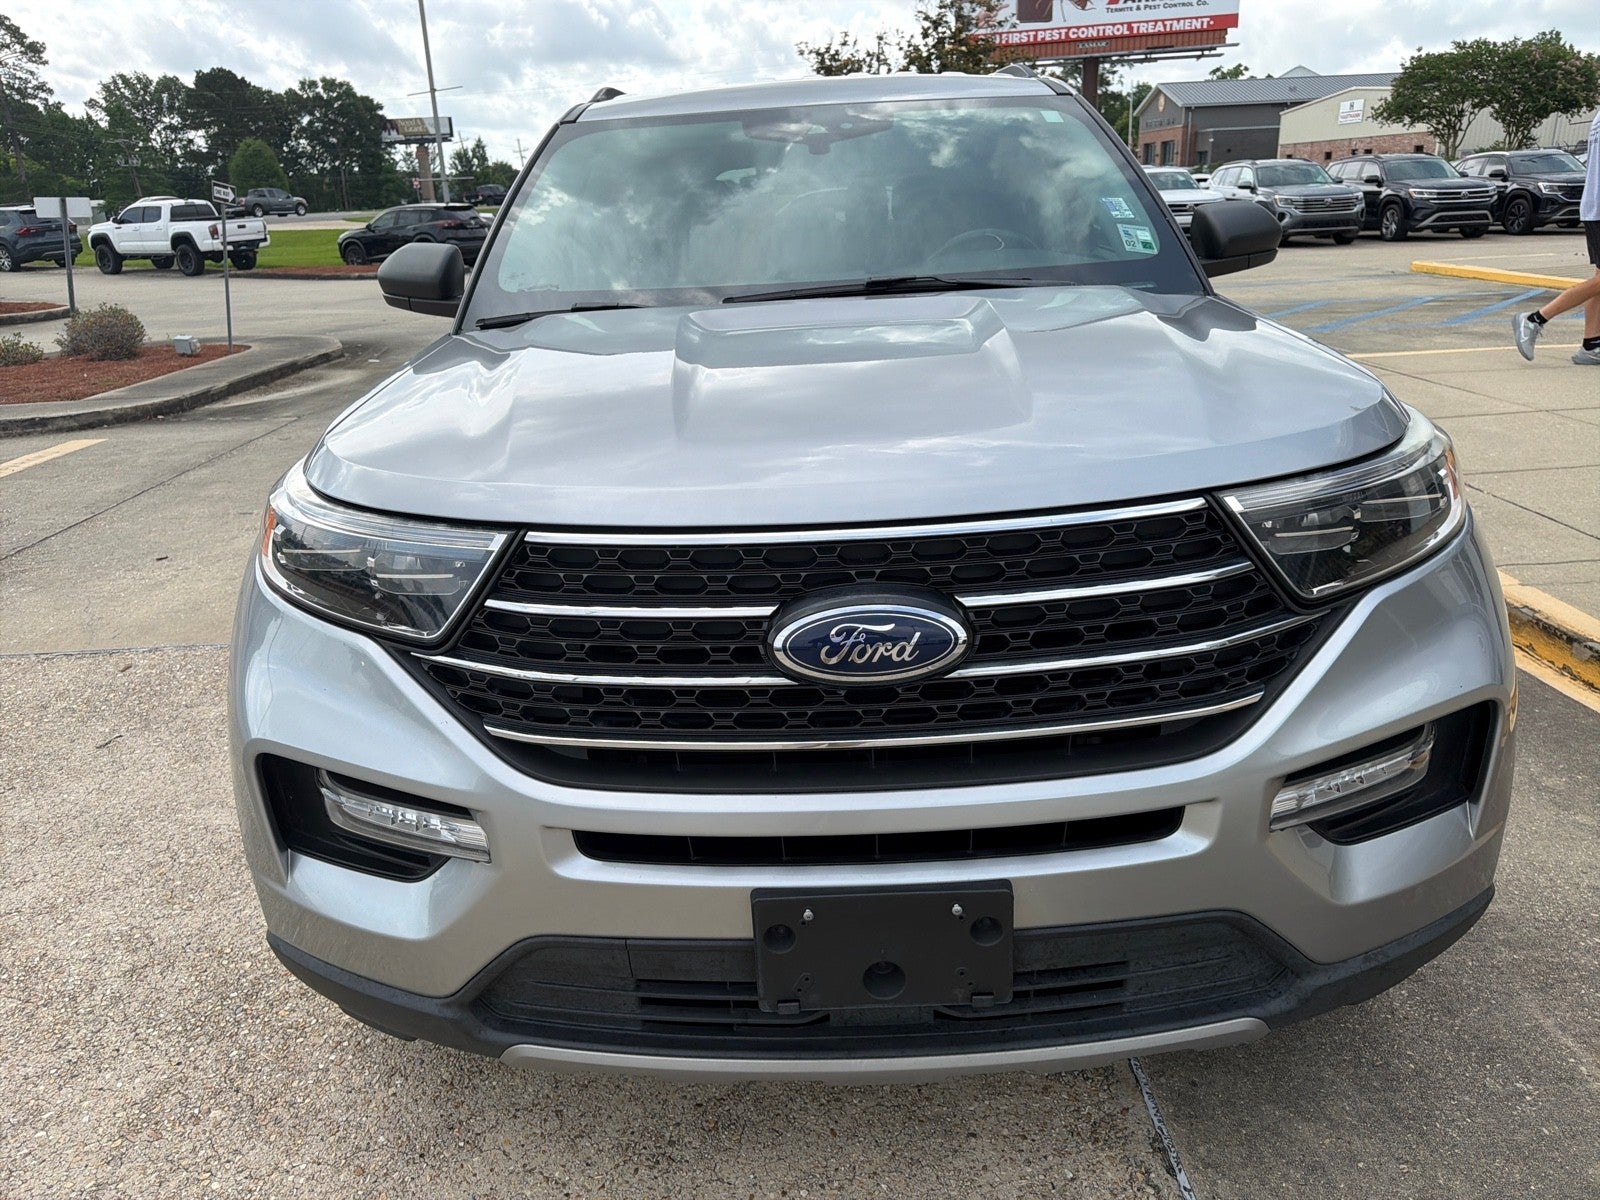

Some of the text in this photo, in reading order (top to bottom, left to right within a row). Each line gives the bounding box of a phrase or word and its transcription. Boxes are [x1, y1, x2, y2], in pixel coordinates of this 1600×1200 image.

[1163, 1, 1194, 9] CONTROL
[1001, 31, 1036, 44] FIRST
[1037, 28, 1068, 41] PEST
[1069, 24, 1130, 38] CONTROL
[214, 187, 222, 196] ONE
[1125, 239, 1137, 248] 02
[819, 623, 921, 665] Ford
